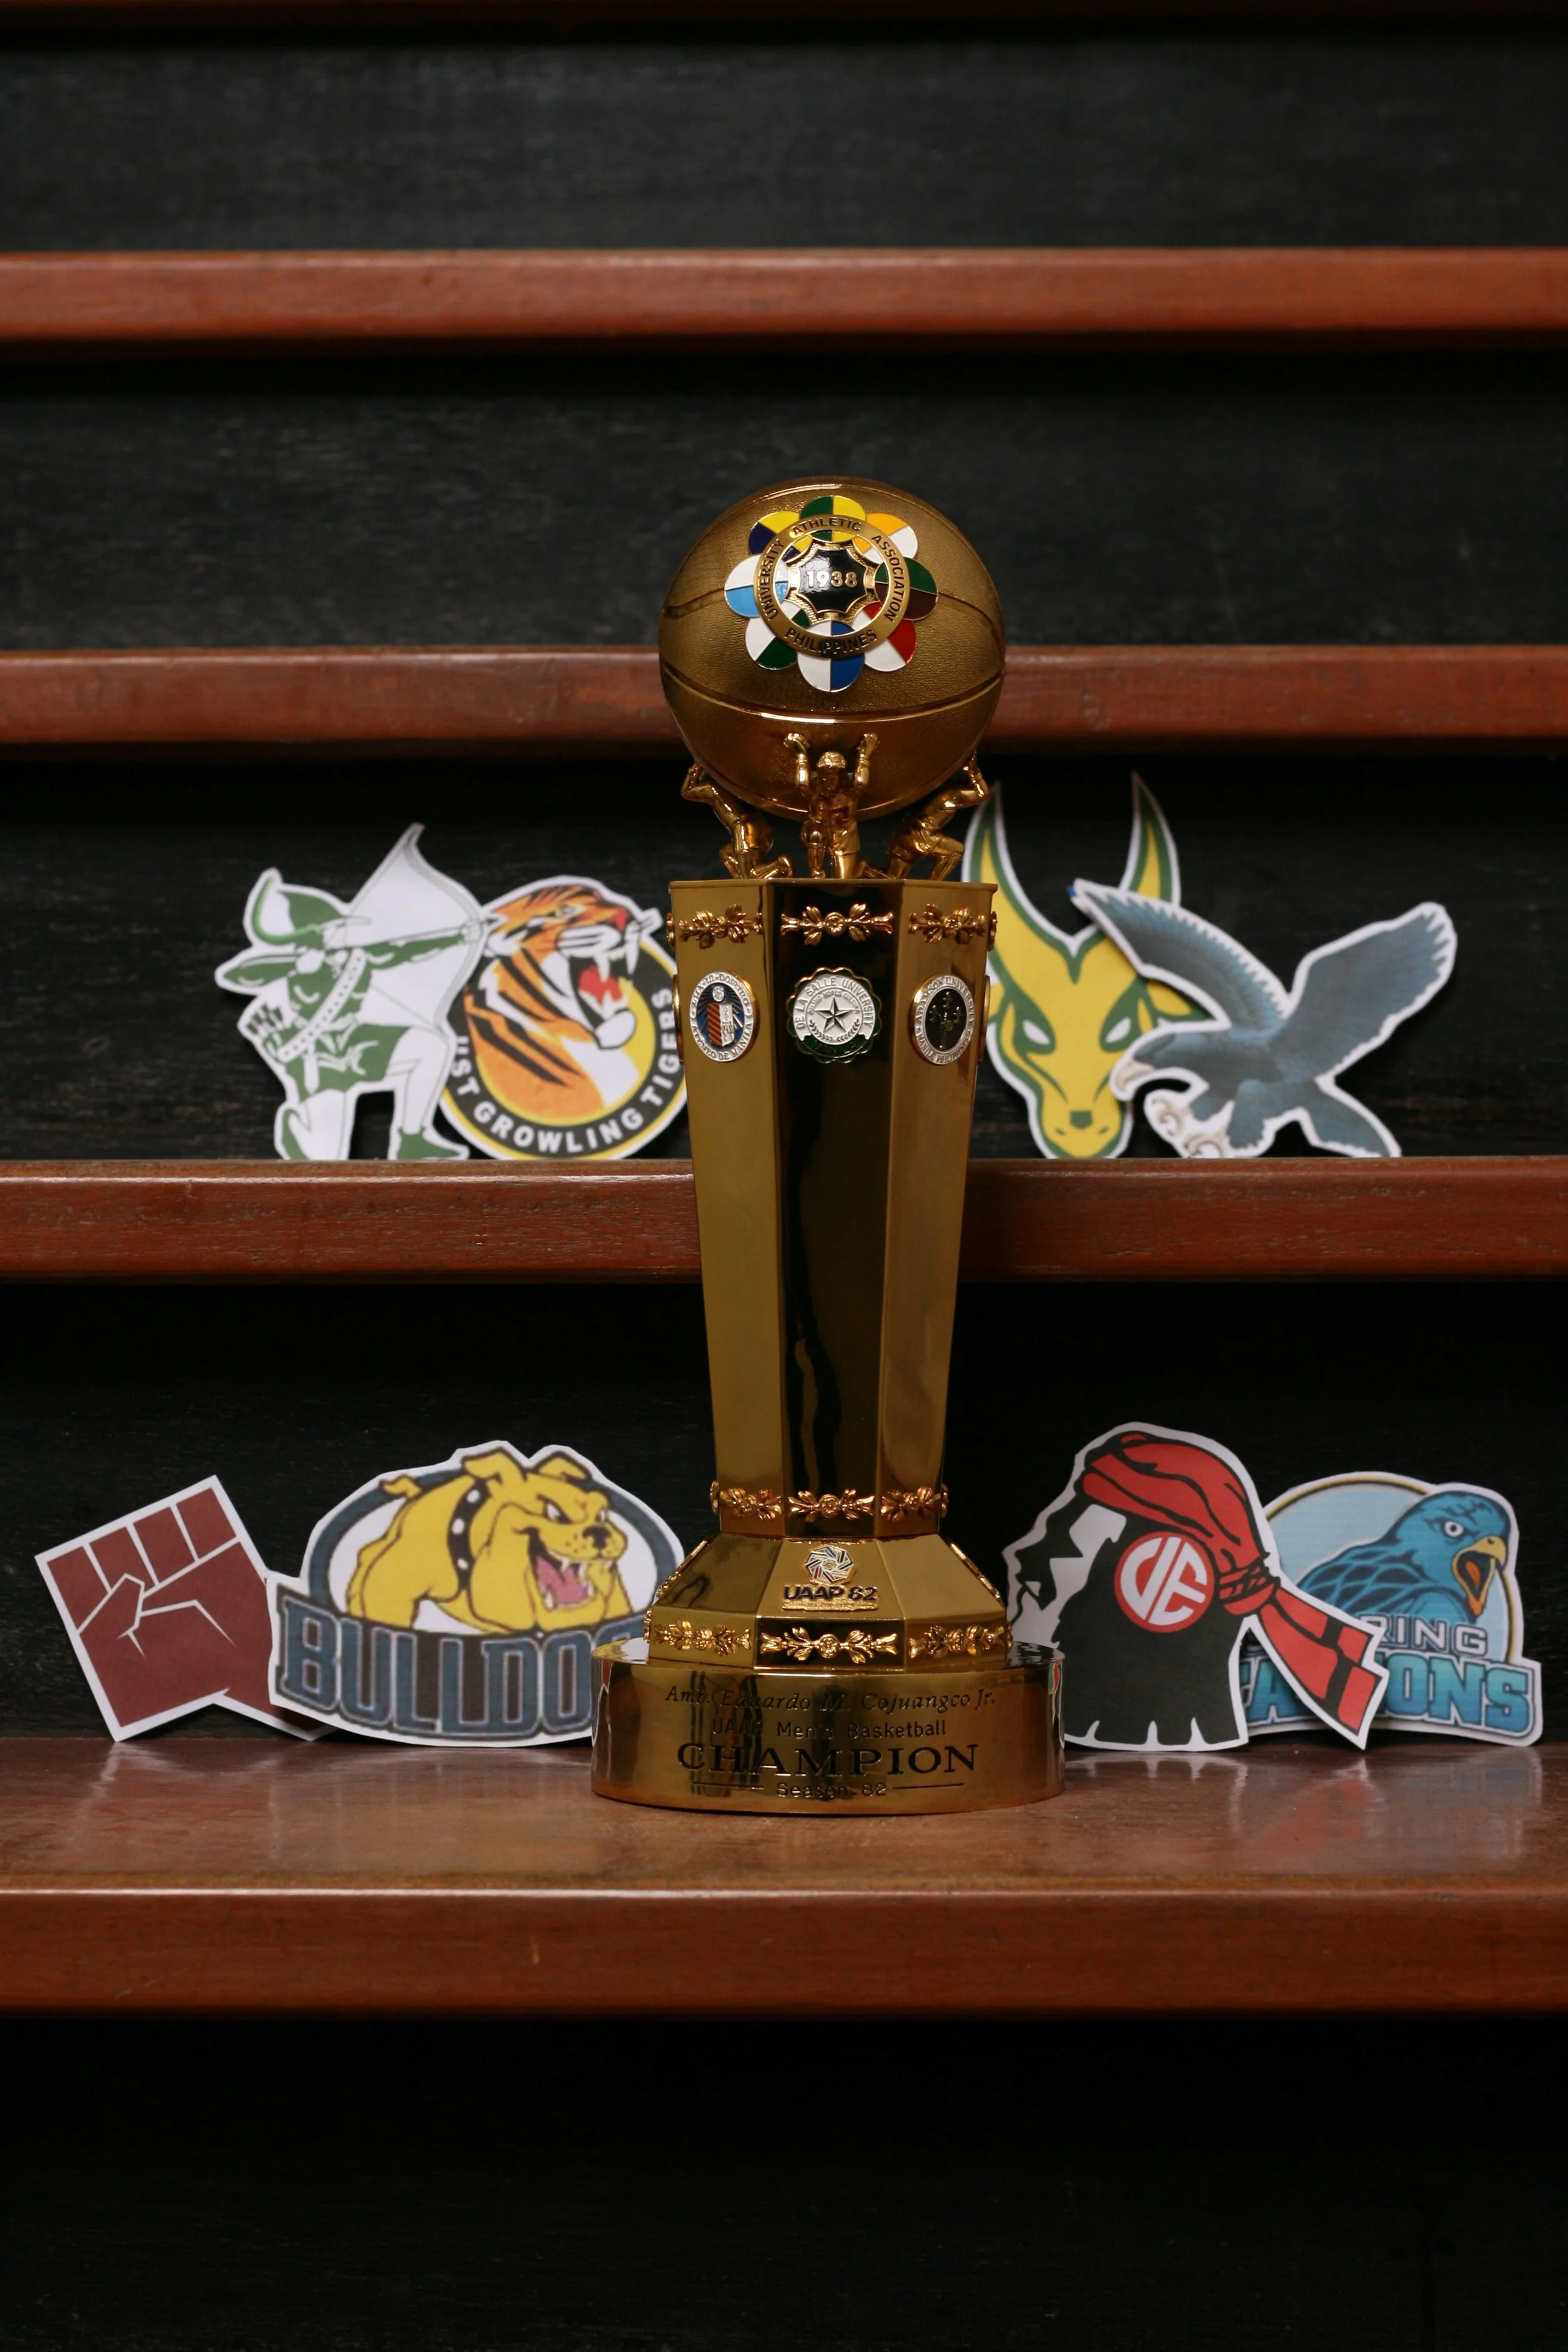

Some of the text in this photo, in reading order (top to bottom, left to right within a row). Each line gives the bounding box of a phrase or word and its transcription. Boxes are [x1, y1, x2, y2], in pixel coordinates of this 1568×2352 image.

[757, 516, 906, 623] UNIVERSITY ATHLETIC ASSOCIATION
[807, 570, 858, 588] 1938
[784, 627, 877, 654] PHILIPPINES
[794, 976, 874, 1030] DE LA SALLE UNIVERSITY
[718, 1052, 729, 1061] DE
[732, 1022, 753, 1058] MANILA
[473, 1100, 644, 1153] GROWLING
[640, 988, 681, 1107] TIGERS
[784, 1585, 878, 1601] UAAP 82
[280, 1593, 646, 1736] BULLDO
[664, 1685, 710, 1705] Amb.
[720, 1690, 811, 1711] Eduardo
[861, 1693, 970, 1715] Cojuangco
[974, 1688, 995, 1710] Jr.
[847, 1719, 946, 1739] Basketball
[677, 1742, 979, 1777] CHAMPION
[776, 1782, 887, 1798] Season 82
